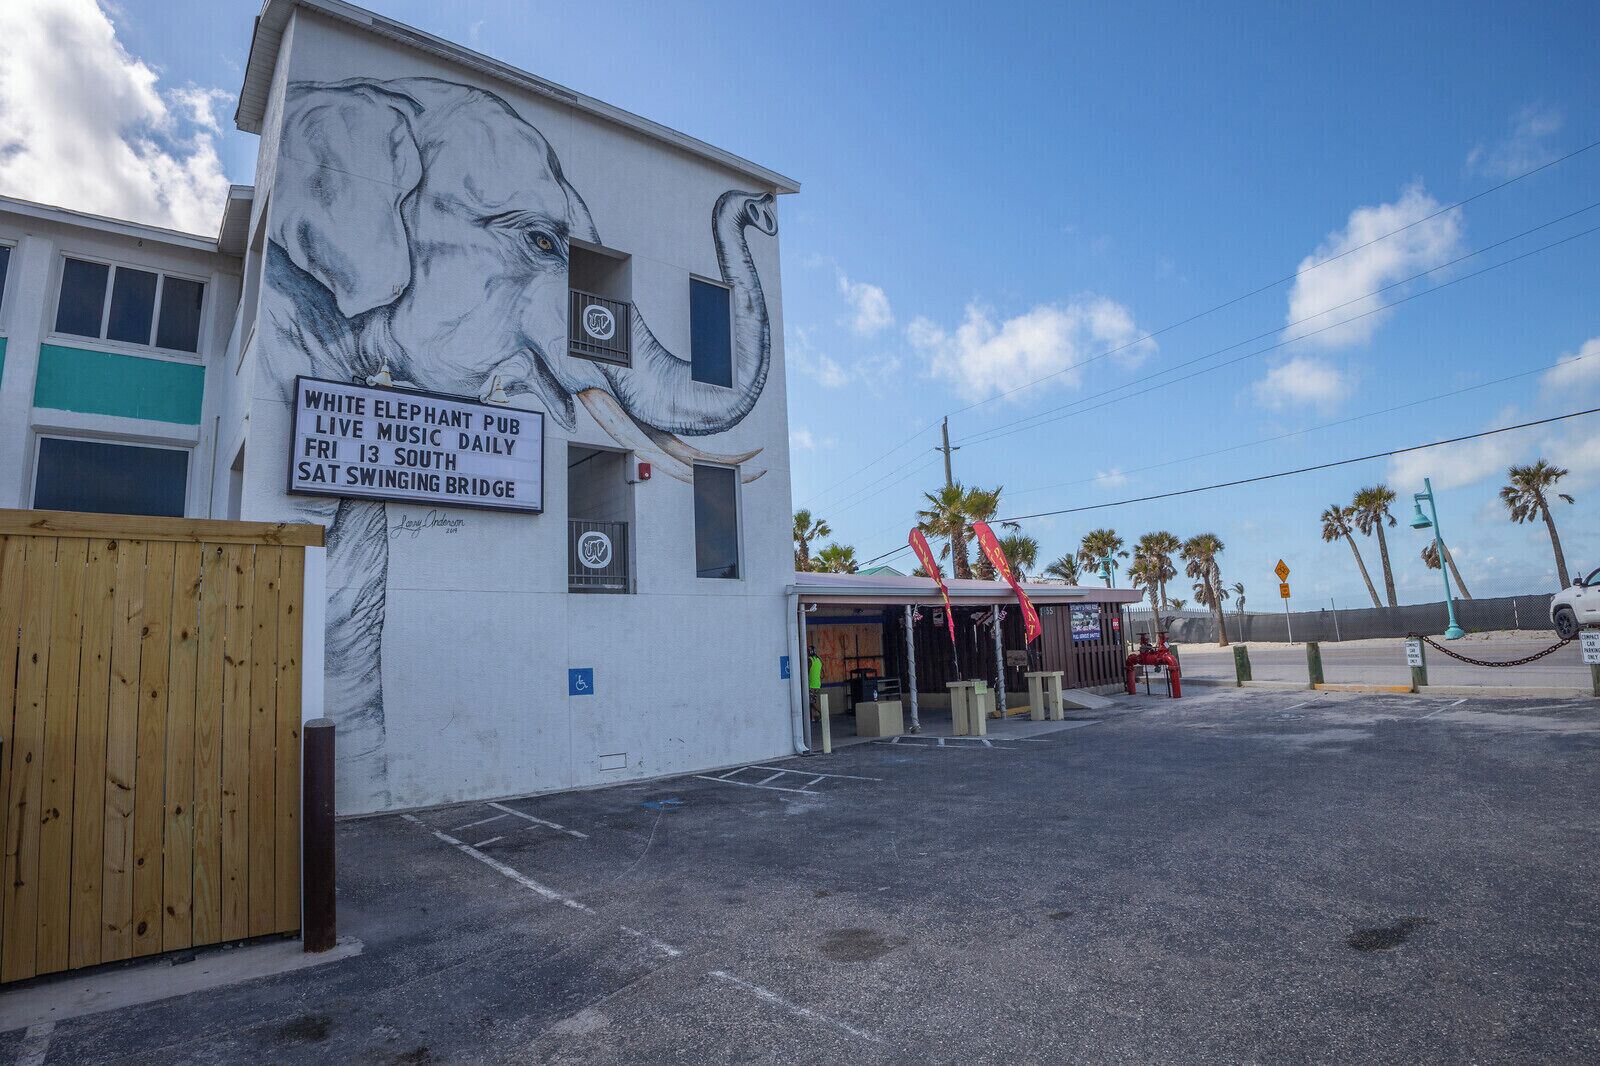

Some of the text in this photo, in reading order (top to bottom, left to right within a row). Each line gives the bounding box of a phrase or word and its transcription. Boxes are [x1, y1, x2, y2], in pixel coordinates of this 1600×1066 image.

[305, 390, 520, 435] WHITE ELEPHANT PUB
[316, 415, 516, 456] LIVE MUSIC DAILY
[305, 438, 457, 471] FRI 13 SOUTH
[298, 462, 515, 498] SAT SWINGING BRIDGE
[424, 509, 465, 529] Anderson
